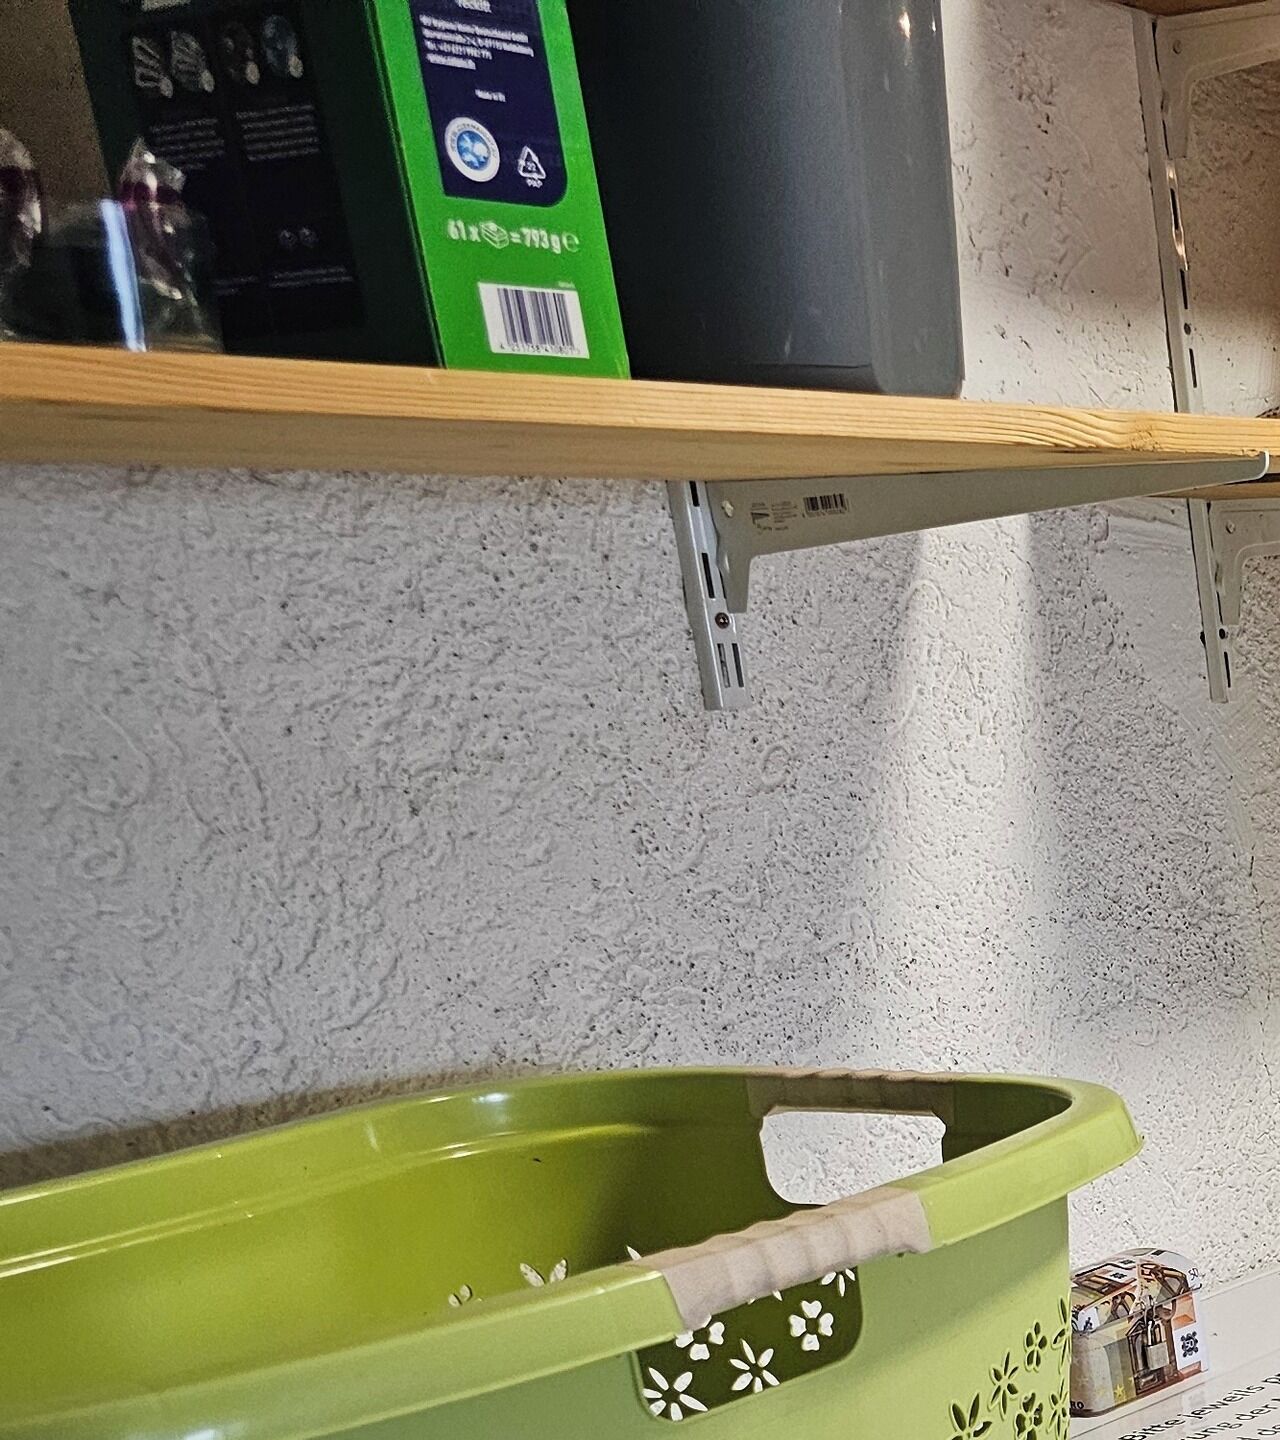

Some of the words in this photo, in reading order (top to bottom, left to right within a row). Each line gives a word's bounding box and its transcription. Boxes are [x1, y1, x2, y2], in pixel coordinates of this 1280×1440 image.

[1070, 1400, 1084, 1409] RO
[1177, 1384, 1264, 1421] jeweils
[1237, 1403, 1278, 1421] der
